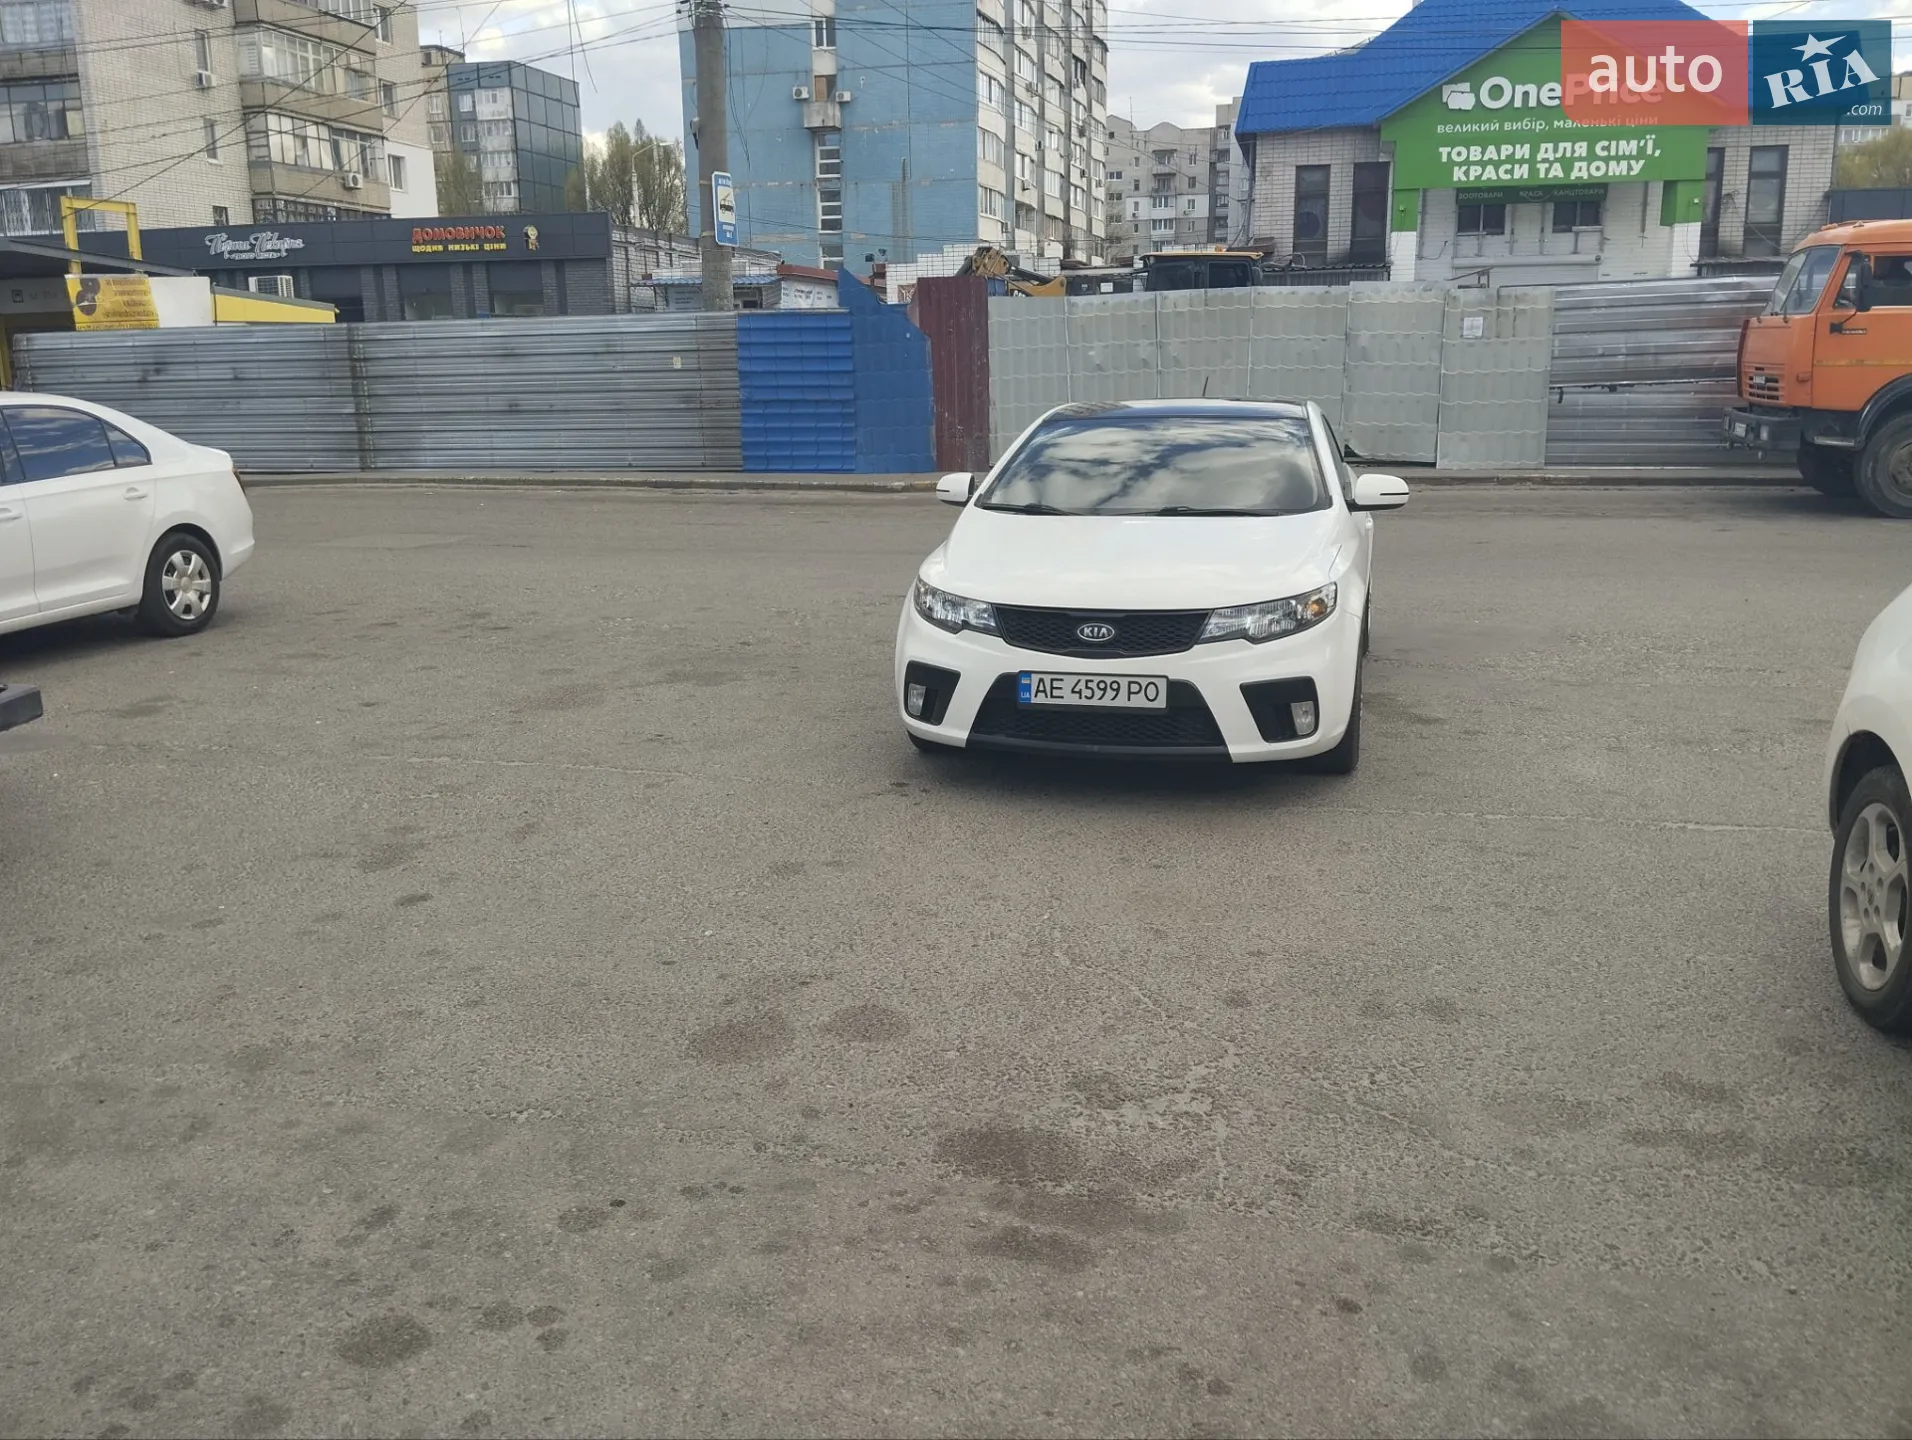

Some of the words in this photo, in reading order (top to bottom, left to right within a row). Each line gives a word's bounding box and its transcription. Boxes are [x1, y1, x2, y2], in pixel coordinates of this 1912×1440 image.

[1437, 120, 1500, 134] великий
[1504, 117, 1549, 132] вибір,
[1625, 114, 1658, 128] ціни
[1439, 143, 1531, 162] ТОВАРИ
[1537, 141, 1588, 161] ДЛЯ
[1453, 163, 1529, 181] КРАСИ
[1536, 162, 1564, 178] ТА
[1570, 159, 1646, 180] ДОМУ
[1458, 191, 1504, 200] ЗООТОВАРИ
[1554, 188, 1605, 197] КАНЦТОВАРИ
[412, 225, 506, 244] ДОМОВИЧОК
[412, 244, 444, 253] ЩОДНЯ
[484, 243, 507, 251] ЦІНИ
[1083, 626, 1109, 637] KIA
[1034, 677, 1064, 699] AE
[1071, 678, 1121, 701] 4599
[1127, 680, 1160, 702] PO
